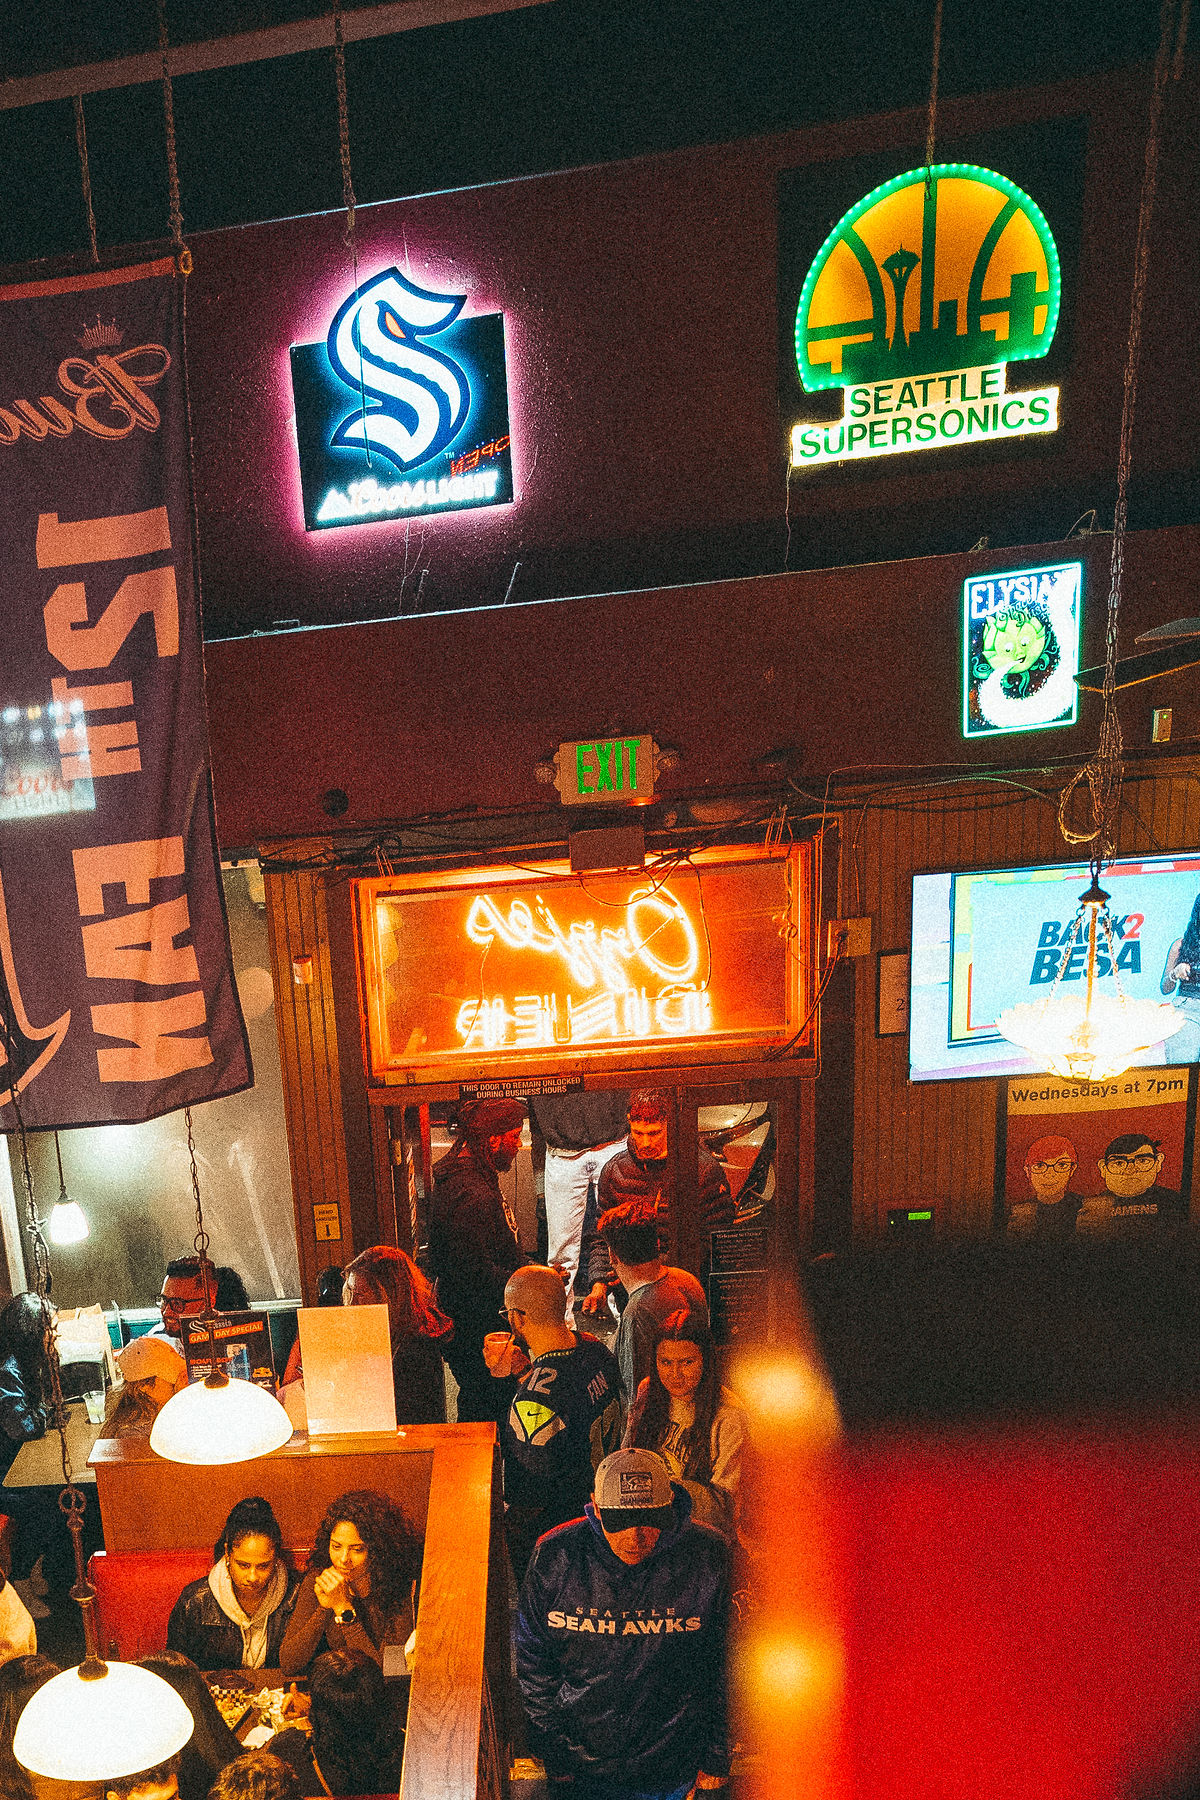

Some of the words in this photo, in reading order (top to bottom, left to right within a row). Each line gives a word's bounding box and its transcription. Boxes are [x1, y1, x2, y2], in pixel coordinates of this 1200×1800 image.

[849, 368, 1001, 418] SEATTLE
[799, 396, 1050, 458] SUPERSONICS
[971, 572, 1061, 619] ELYSIA
[575, 739, 641, 795] EXIT
[1029, 940, 1142, 985] BESA
[462, 1084, 479, 1092] THIS
[480, 1083, 500, 1091] DOOR
[501, 1082, 512, 1090] TO
[513, 1080, 541, 1089] REMAIN
[542, 1076, 581, 1087] UNLOCKED
[476, 1090, 504, 1099] DURING
[505, 1087, 541, 1097] BUSINESS
[542, 1085, 567, 1094] HOURS
[1011, 1080, 1118, 1103] Wednesdays
[1123, 1078, 1141, 1094] at
[1146, 1077, 1184, 1095] 7pm
[189, 1331, 215, 1344] GAM
[215, 1327, 231, 1338] DAY
[231, 1322, 263, 1337] SPECIAL
[527, 1367, 558, 1395] 12
[586, 1370, 609, 1406] FAN
[547, 1610, 701, 1636] SEAHAWKS
[575, 1607, 676, 1619] SEATTLE
